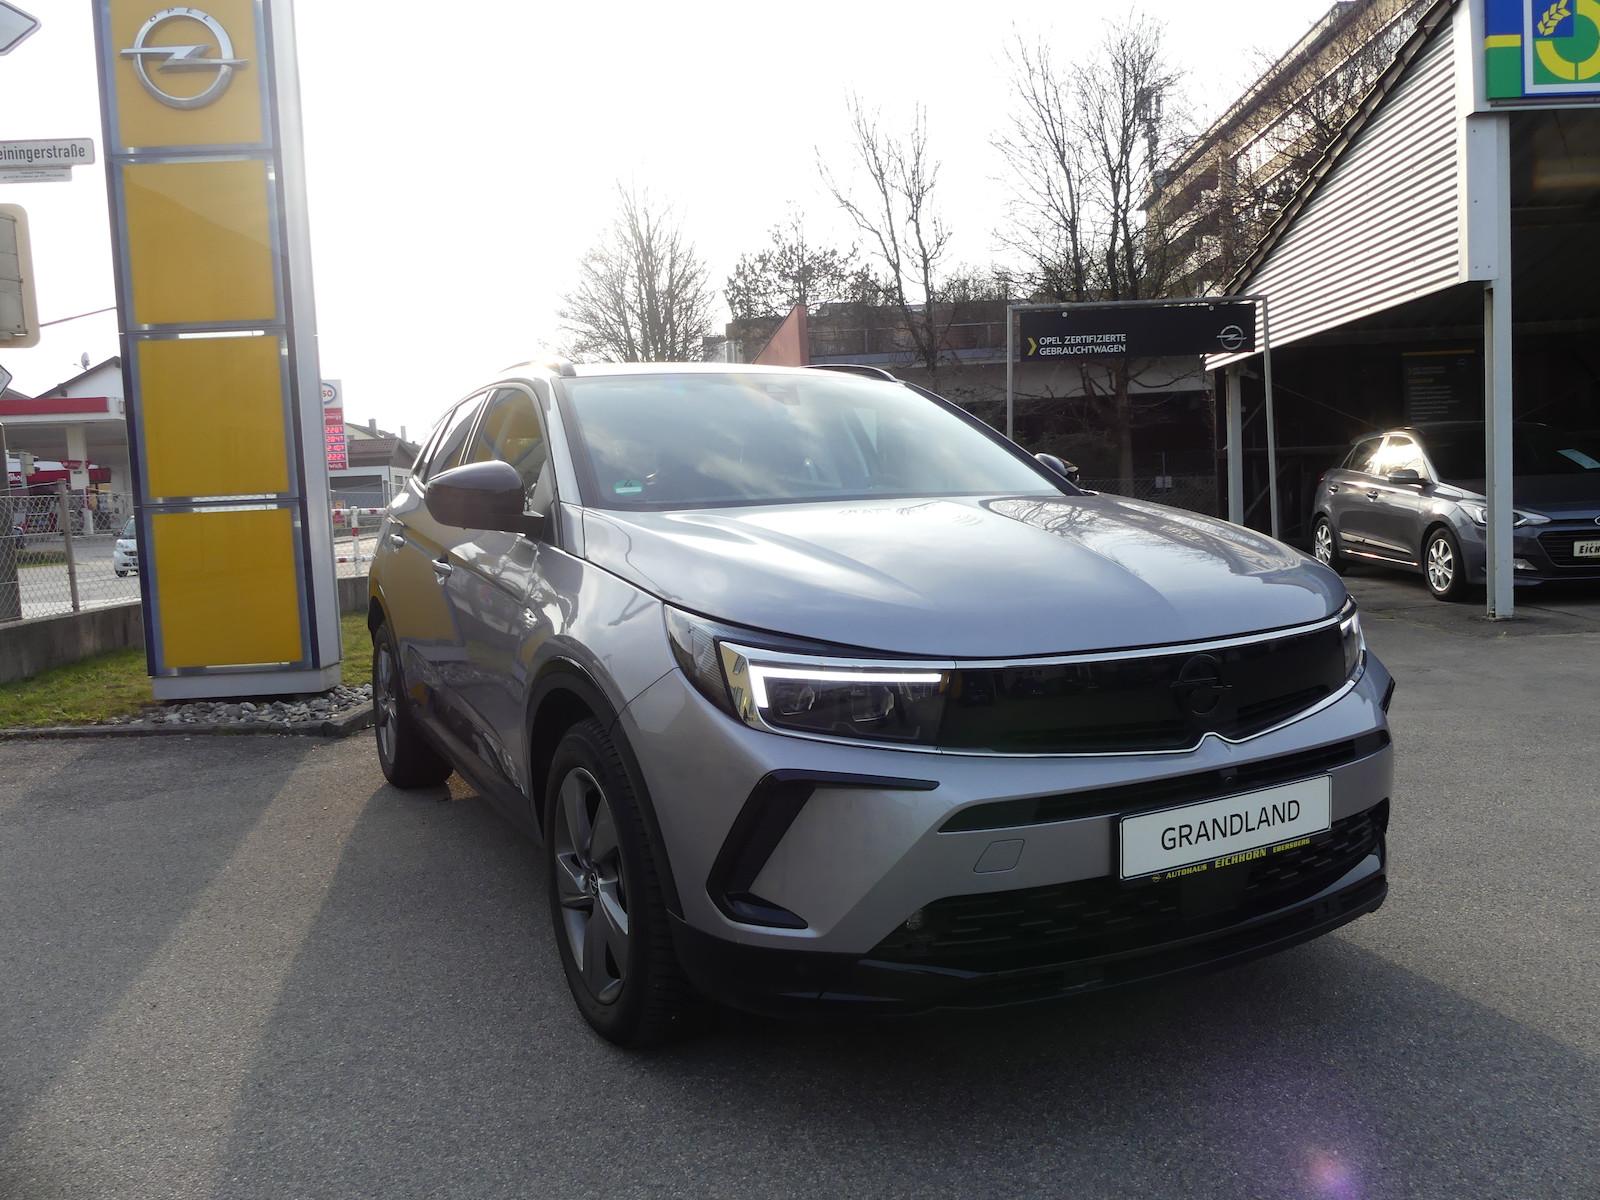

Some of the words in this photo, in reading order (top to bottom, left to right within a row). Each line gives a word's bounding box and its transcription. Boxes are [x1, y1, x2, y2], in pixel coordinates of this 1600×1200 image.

[149, 7, 209, 22] OPEL
[1039, 336, 1062, 345] OPEL
[1064, 333, 1126, 345] ZERTIFIZIERTE
[1039, 344, 1126, 356] GEBRAUCHTWAGEN
[1161, 799, 1301, 851] GRANDLAND
[1165, 863, 1208, 880] AUTOHAUS
[1214, 848, 1267, 869] EICHHORN
[1272, 838, 1311, 853] EBERSBERG
